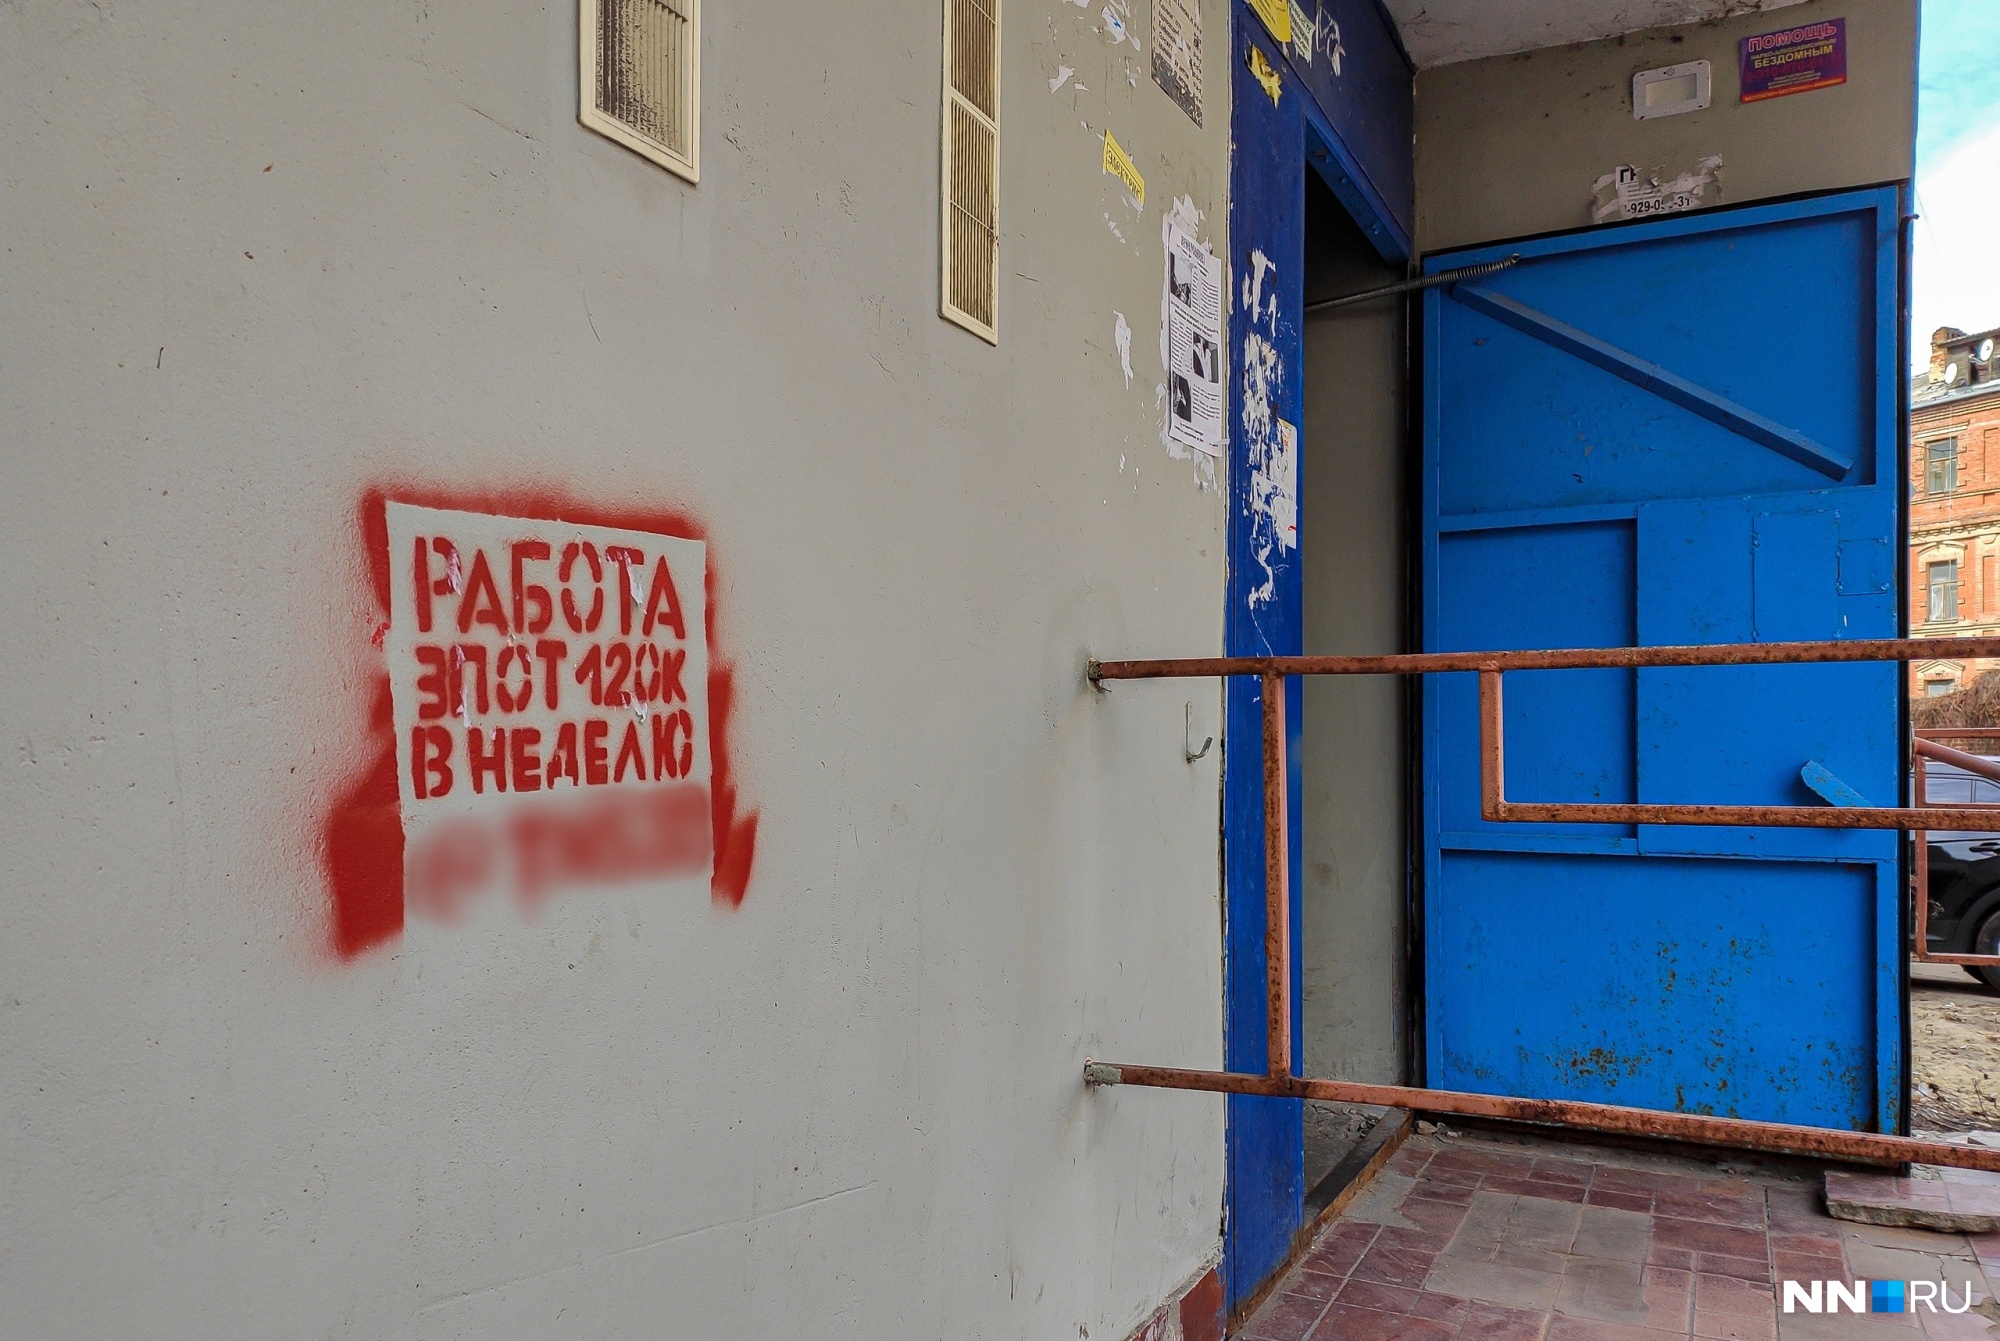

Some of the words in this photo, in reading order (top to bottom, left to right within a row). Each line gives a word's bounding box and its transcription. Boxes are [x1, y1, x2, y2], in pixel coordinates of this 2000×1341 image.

[1748, 22, 1837, 52] ПОМОЩЬ
[1754, 44, 1833, 69] БЕЗДОМНЫМ
[413, 535, 687, 640] РАБОТА
[411, 724, 454, 800] В
[468, 708, 693, 795] НЕДЕЛЮ
